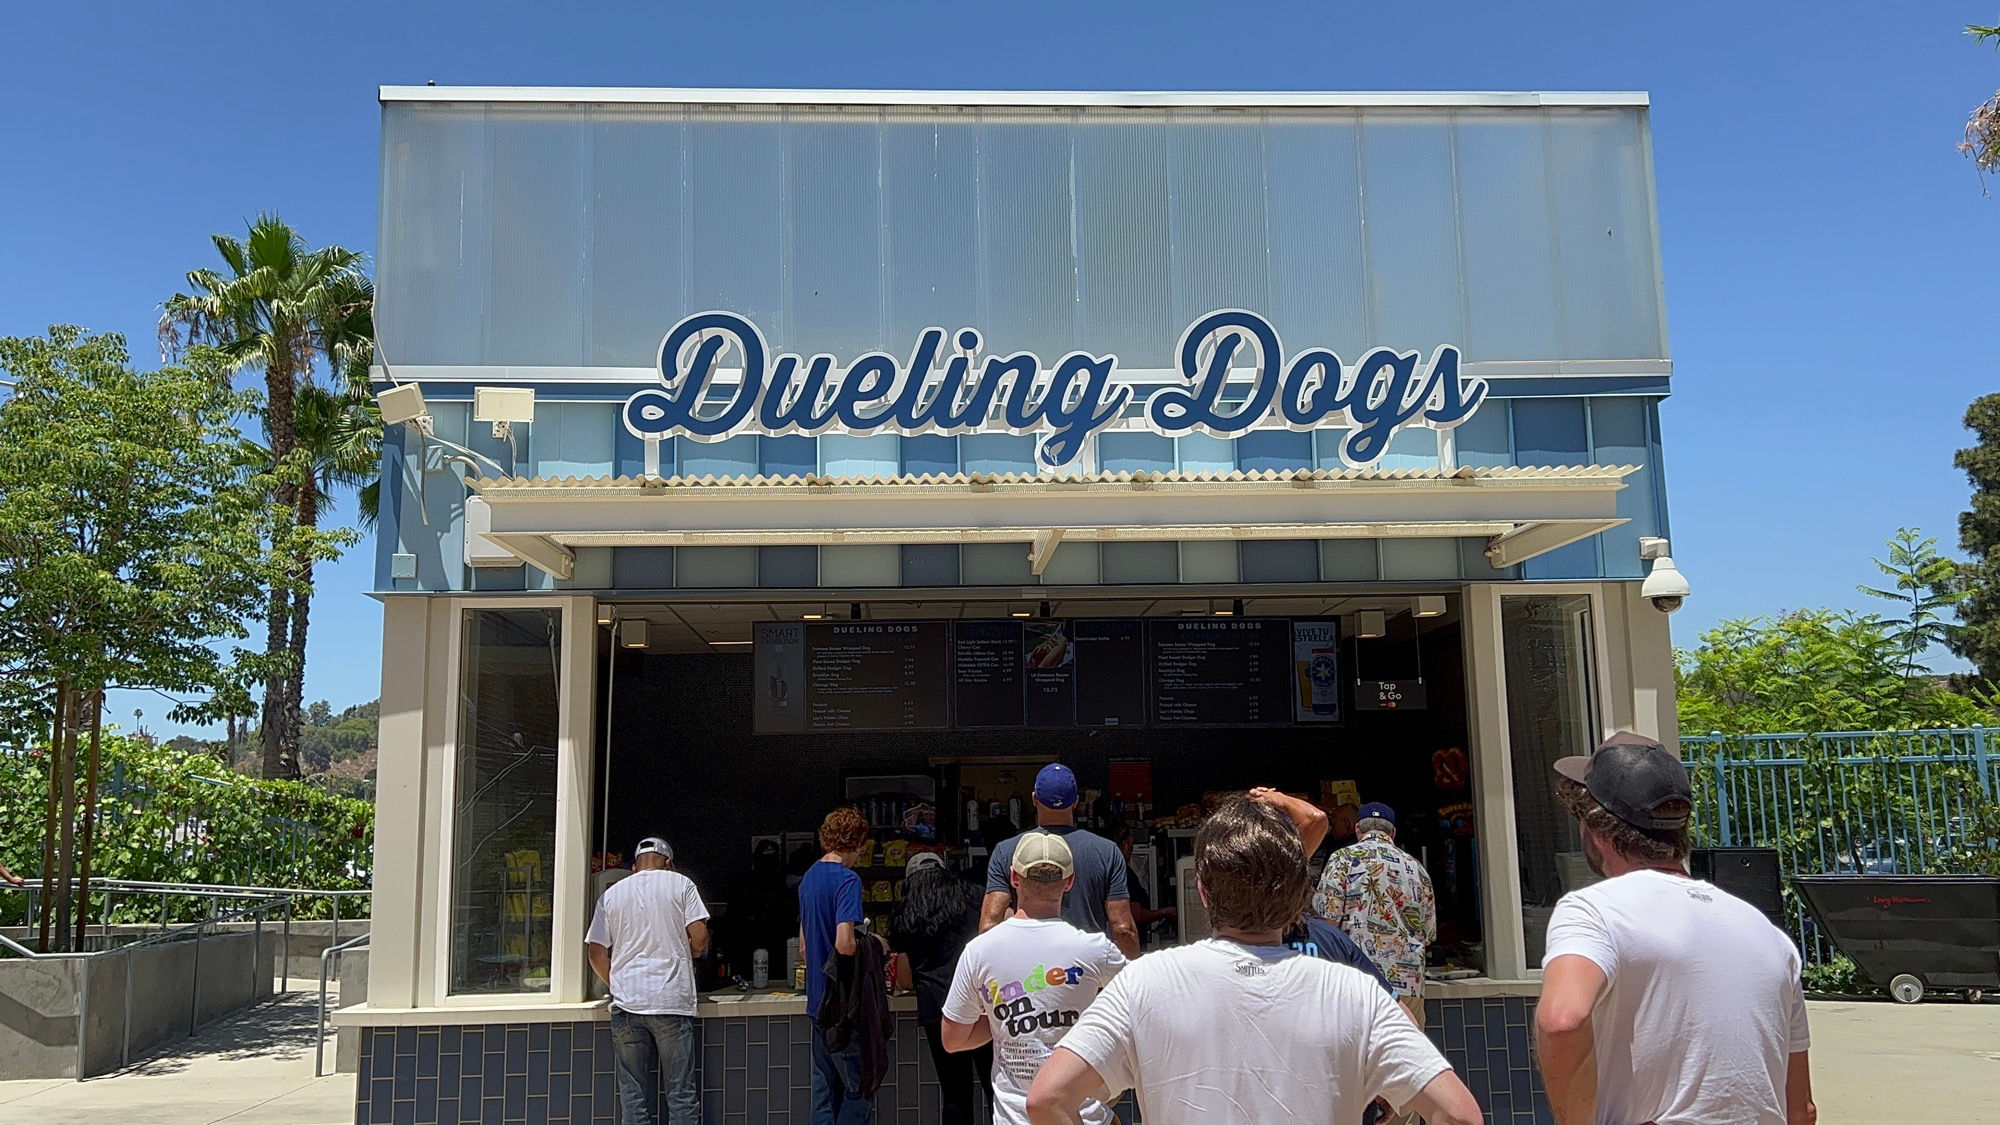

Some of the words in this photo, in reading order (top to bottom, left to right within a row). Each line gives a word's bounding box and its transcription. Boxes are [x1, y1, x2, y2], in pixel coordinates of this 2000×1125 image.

[626, 311, 1131, 470] Dueling
[1150, 309, 1486, 468] Dogs
[833, 626, 883, 634] DUELING
[887, 625, 918, 633] DOGS
[1231, 622, 1262, 630] DOGS
[760, 627, 800, 640] SMART
[1377, 681, 1396, 691] Tap
[1379, 691, 1387, 700] &
[1387, 691, 1402, 700] Go
[979, 963, 1084, 1005] tinder
[994, 996, 1036, 1020] on
[1006, 1009, 1080, 1038] tour
